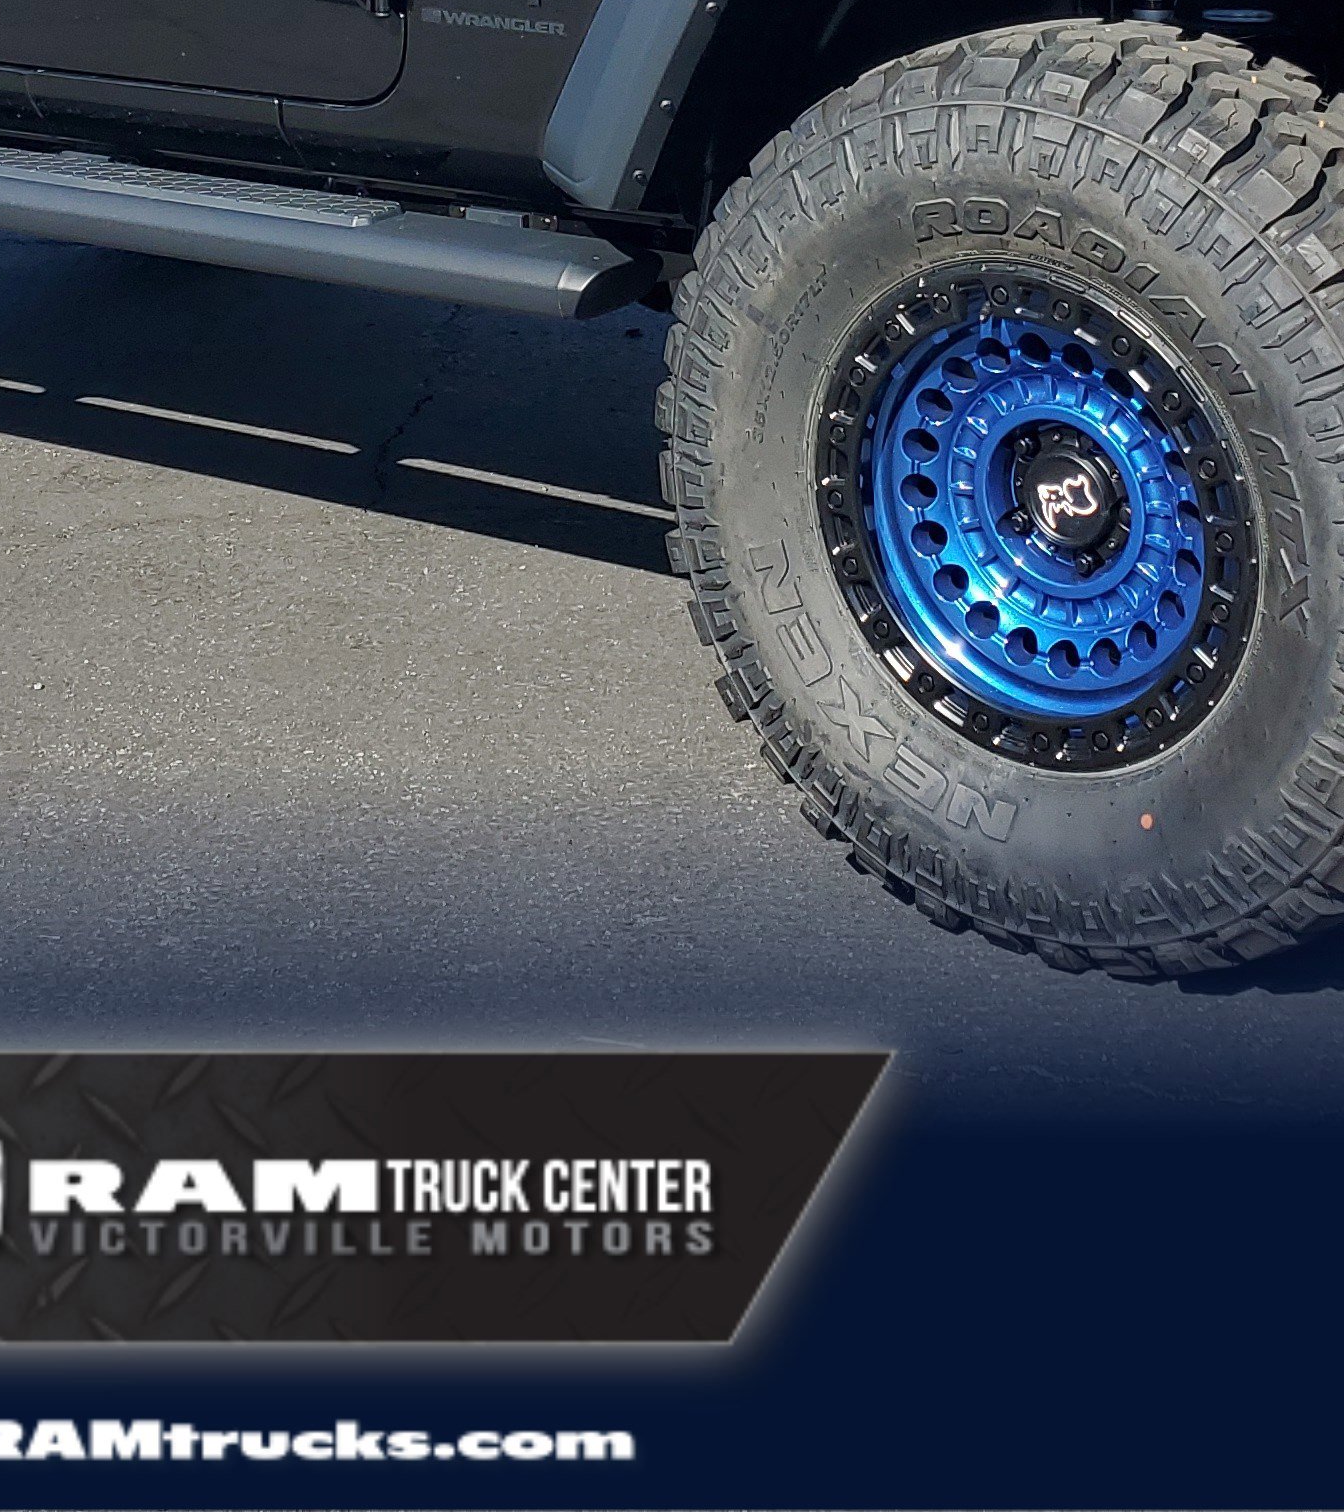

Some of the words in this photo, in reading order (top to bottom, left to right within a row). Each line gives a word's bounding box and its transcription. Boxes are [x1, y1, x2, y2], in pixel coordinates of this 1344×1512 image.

[442, 10, 567, 37] WRANGLER
[910, 196, 1257, 396] ROADIAN
[1248, 428, 1311, 638] MTX
[748, 538, 1018, 843] NEXEN
